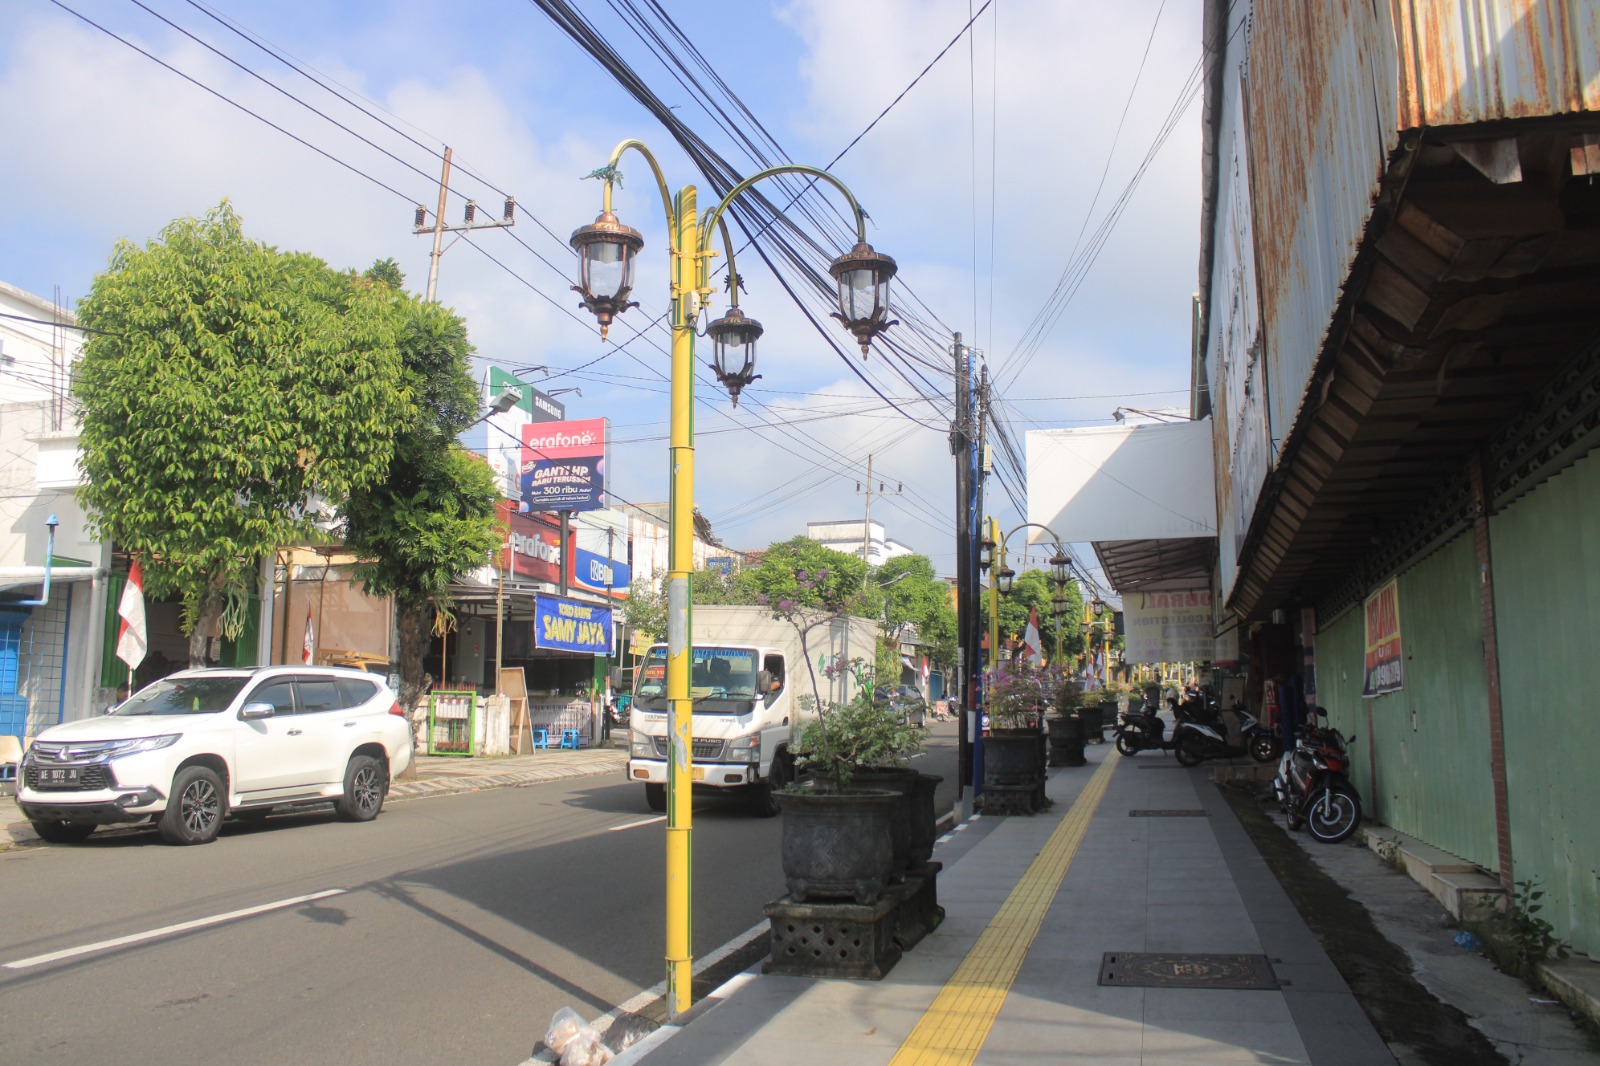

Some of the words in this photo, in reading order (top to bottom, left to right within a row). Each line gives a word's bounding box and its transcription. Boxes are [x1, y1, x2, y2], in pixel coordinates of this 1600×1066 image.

[535, 396, 562, 420] SAMSUNG
[529, 432, 592, 449] erafone
[534, 466, 570, 480] GANTI
[572, 465, 589, 477] HP
[531, 477, 552, 487] BARU
[543, 486, 561, 495] 300
[561, 485, 578, 494] ribu
[577, 621, 605, 645] JAYA
[41, 769, 49, 779] AE
[52, 769, 65, 779] 1072
